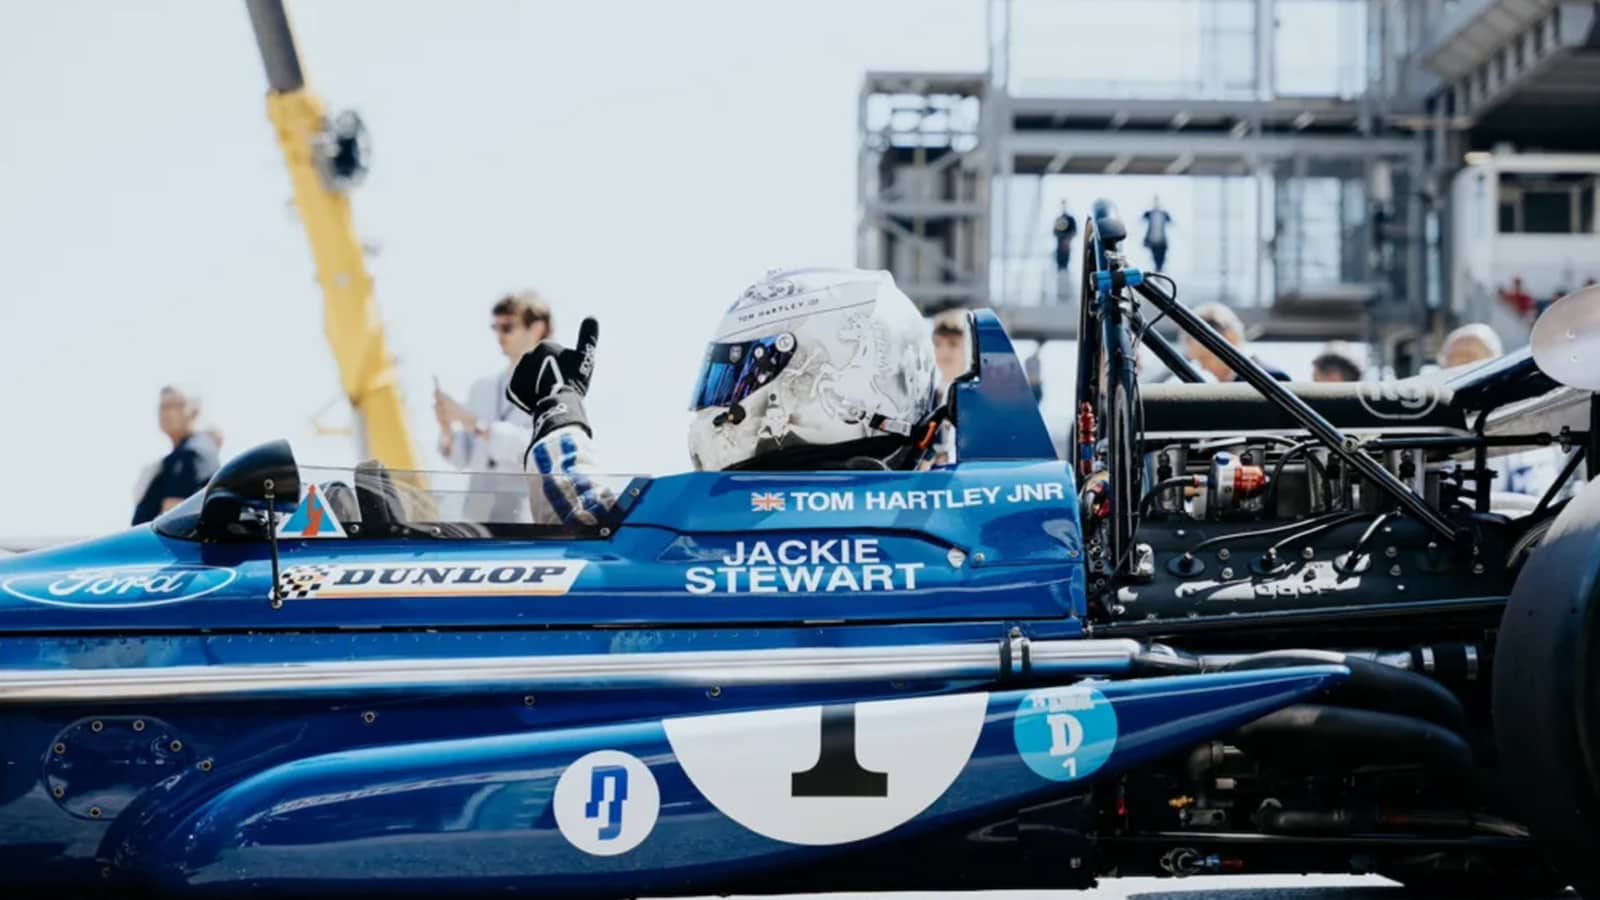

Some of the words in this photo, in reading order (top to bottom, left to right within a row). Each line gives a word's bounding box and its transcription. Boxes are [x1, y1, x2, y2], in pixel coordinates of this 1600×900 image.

[790, 492, 854, 511] TOM
[865, 487, 1000, 509] HARTLEY
[1006, 482, 1064, 502] JNR
[722, 539, 880, 566] JACKIE
[48, 571, 187, 596] Ford
[333, 566, 567, 586] DUNLOP
[684, 563, 925, 594] STEWART
[1046, 713, 1083, 757] D
[1062, 757, 1077, 778] 1
